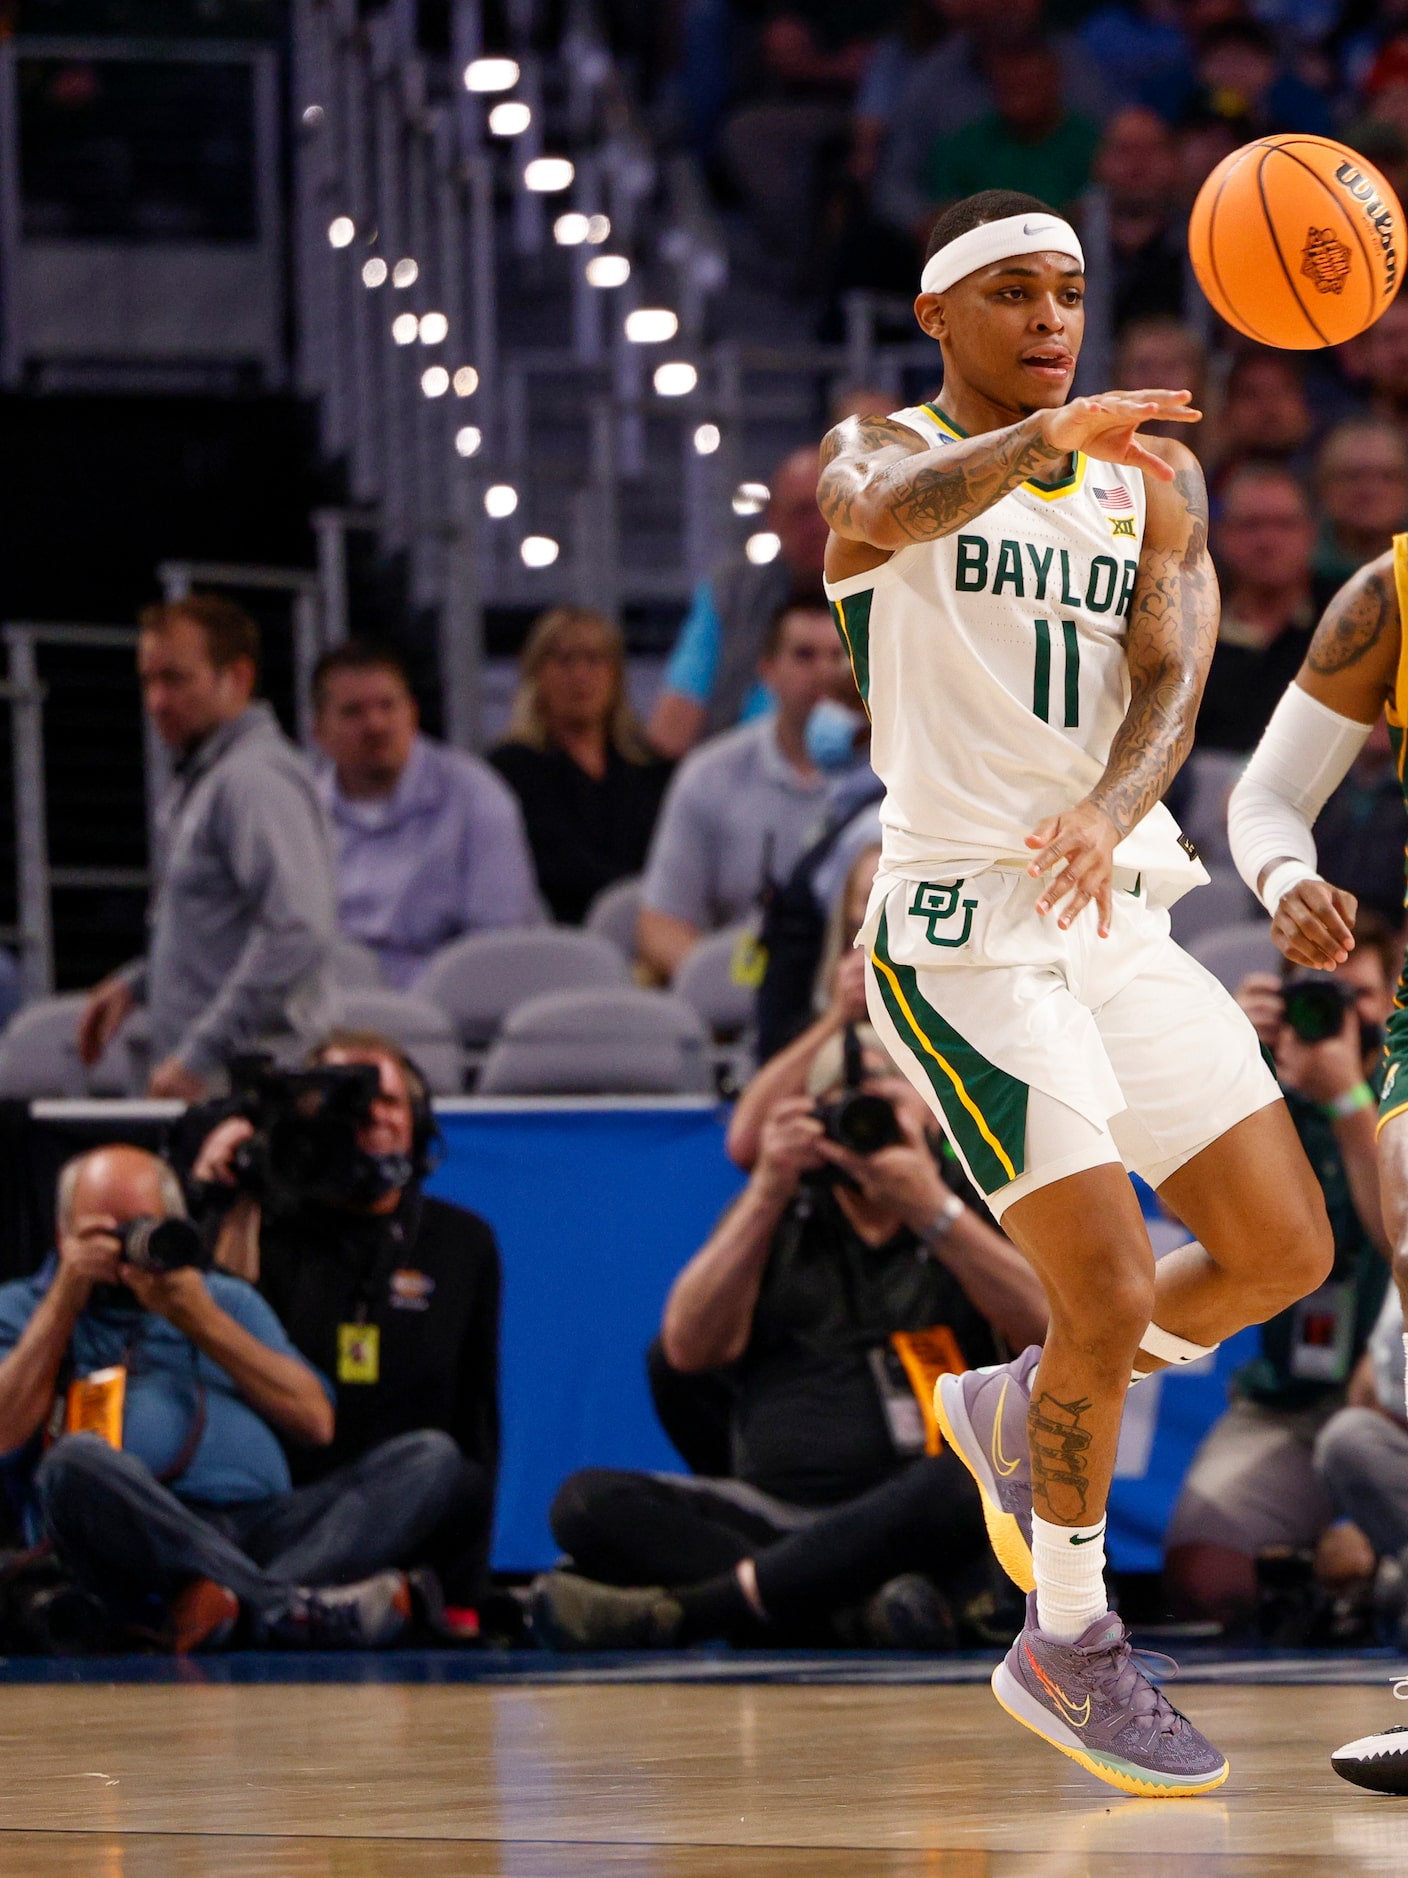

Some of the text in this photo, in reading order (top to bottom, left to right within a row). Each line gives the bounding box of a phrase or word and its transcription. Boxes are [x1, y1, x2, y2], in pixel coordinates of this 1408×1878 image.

[1335, 159, 1396, 296] Wilson
[1107, 517, 1136, 537] XII
[1033, 620, 1080, 728] 11
